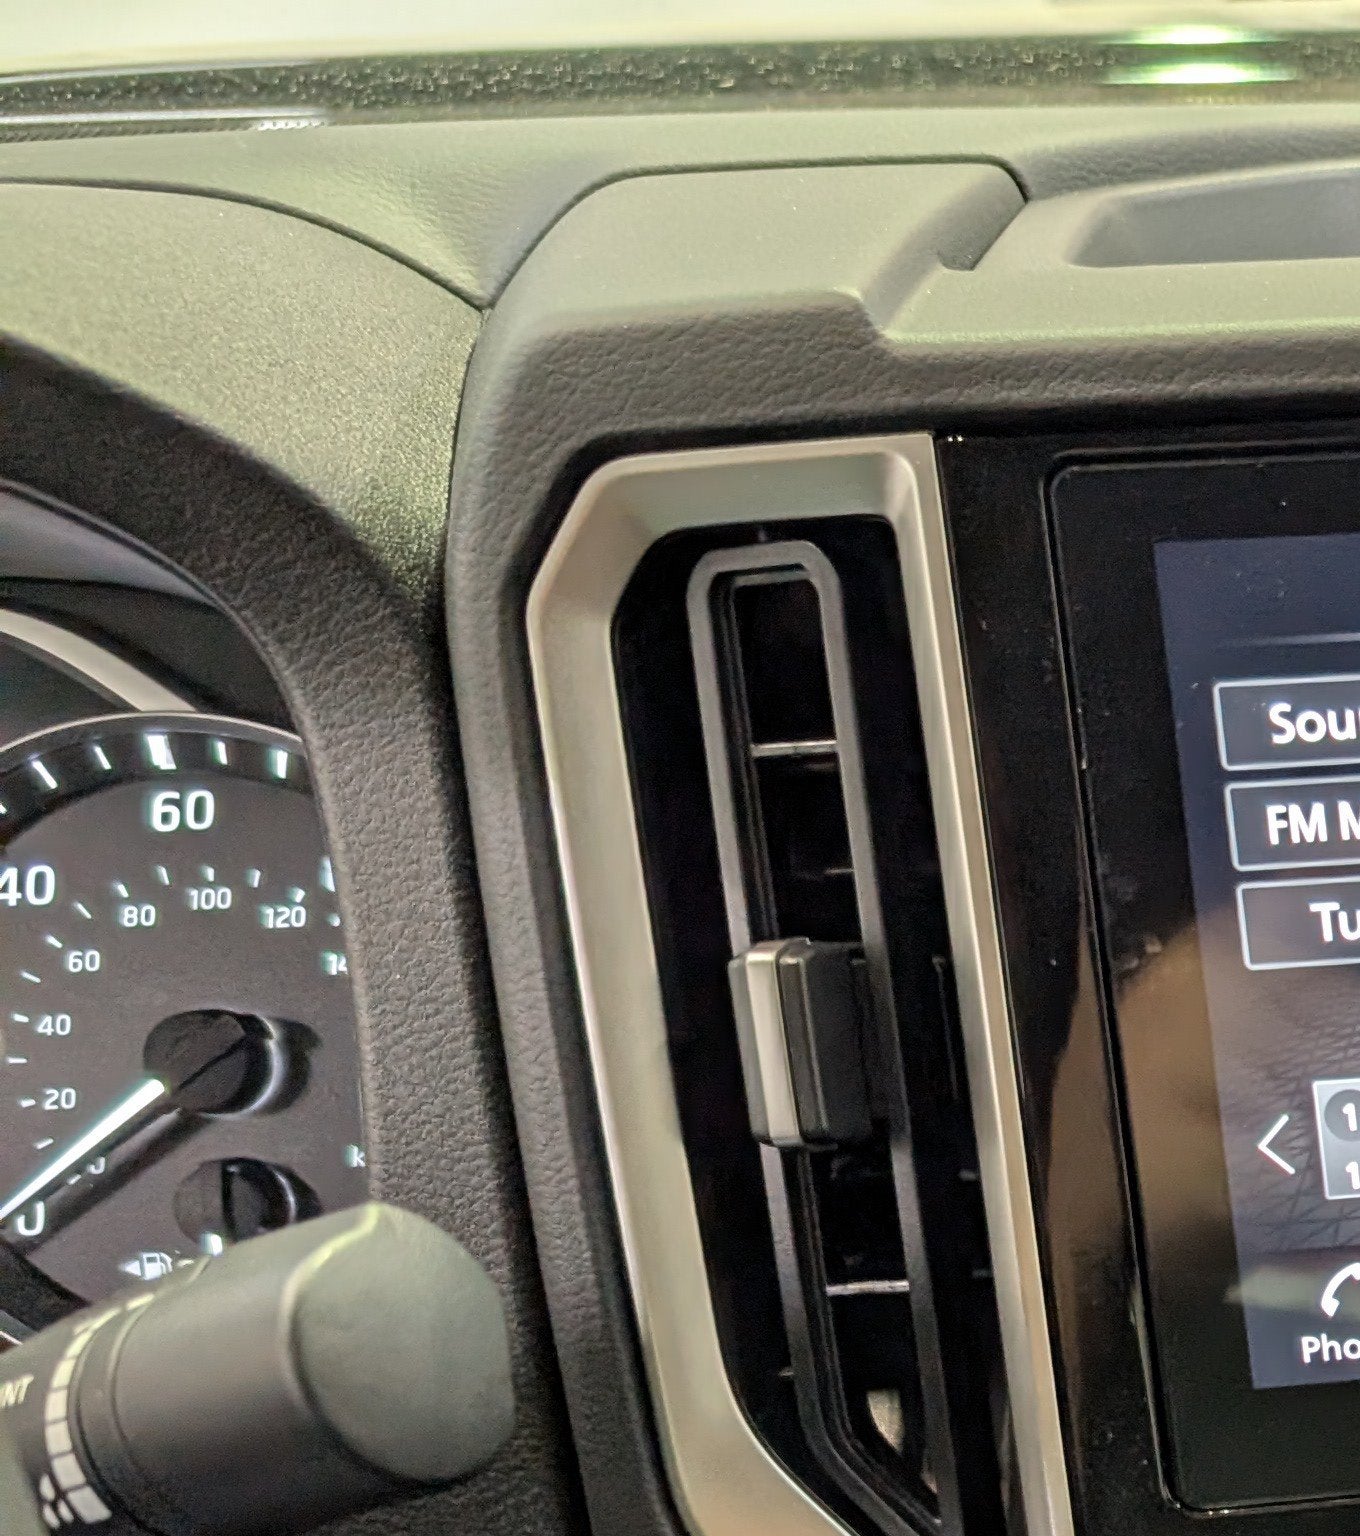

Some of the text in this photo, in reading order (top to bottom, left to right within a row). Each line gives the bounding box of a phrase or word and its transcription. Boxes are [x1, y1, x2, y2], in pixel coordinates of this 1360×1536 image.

[150, 790, 215, 832] 60
[1265, 801, 1328, 846] FM
[0, 864, 55, 906] 40
[187, 887, 233, 911] 100
[120, 904, 157, 927] 80
[260, 906, 307, 929] 120
[67, 949, 101, 973] 60
[37, 1014, 72, 1036] 40
[42, 1088, 77, 1110] 20
[1342, 1102, 1358, 1132] 1
